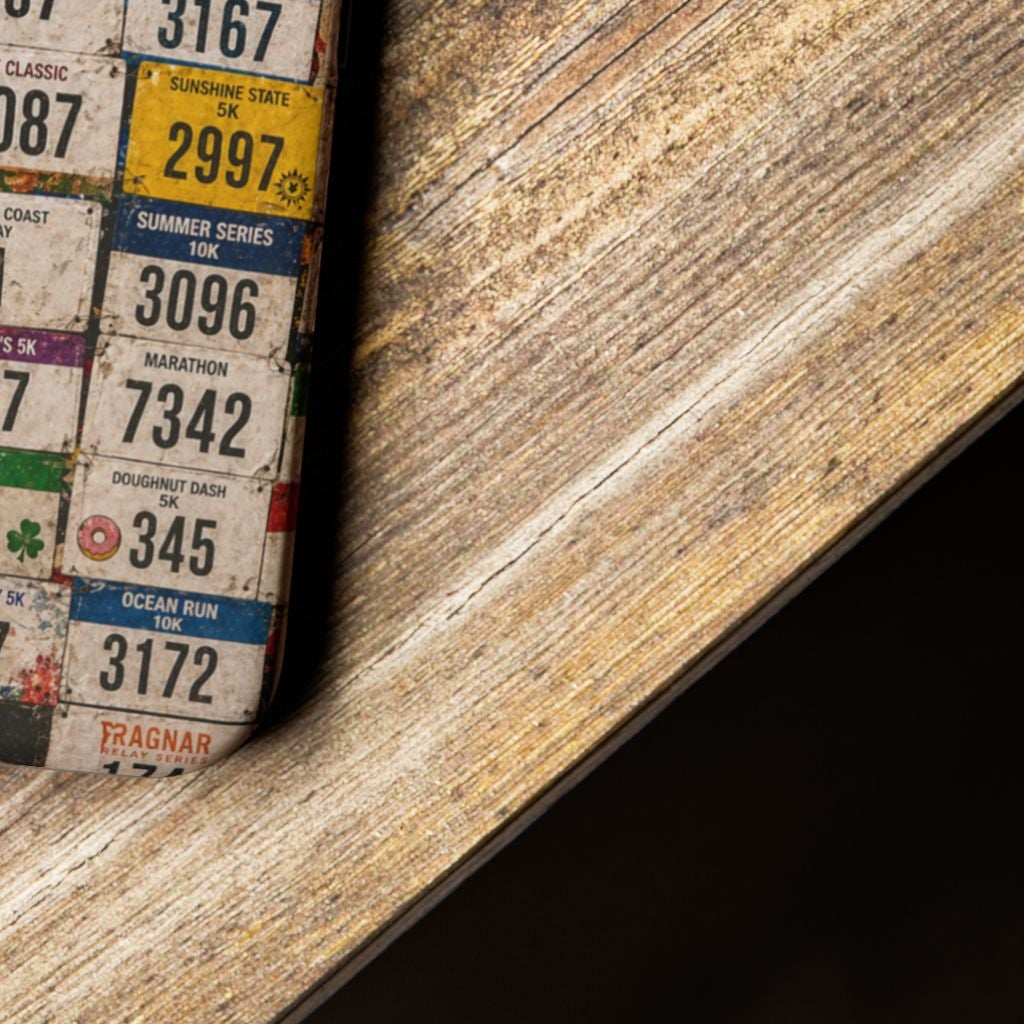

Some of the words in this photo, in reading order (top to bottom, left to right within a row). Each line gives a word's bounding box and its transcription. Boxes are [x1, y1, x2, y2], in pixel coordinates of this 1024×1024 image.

[5, 60, 69, 82] CLASSIC
[170, 76, 244, 100] SUNSHINE
[248, 88, 290, 107] STATE
[216, 102, 239, 119] 5K
[163, 121, 285, 192] 2997
[4, 207, 50, 224] COAST
[136, 211, 211, 238] SUMMER
[215, 221, 274, 246] SERIES
[189, 241, 219, 259] 10K
[135, 265, 259, 340] 3096
[17, 338, 37, 355] 5K
[144, 352, 229, 377] MARATHON
[121, 378, 252, 458] 7342
[112, 471, 187, 493] DOUGHNUT
[190, 481, 227, 498] DASH
[159, 494, 180, 509] 5K
[129, 510, 218, 576] 345
[6, 590, 25, 607] 5K
[121, 591, 178, 614] OCEAN
[182, 601, 219, 620] RUN
[153, 615, 183, 632] 10K
[99, 633, 219, 704] 3172
[100, 721, 212, 755] RAGNAR
[100, 747, 149, 759] RELAY
[155, 753, 209, 766] SERIES
